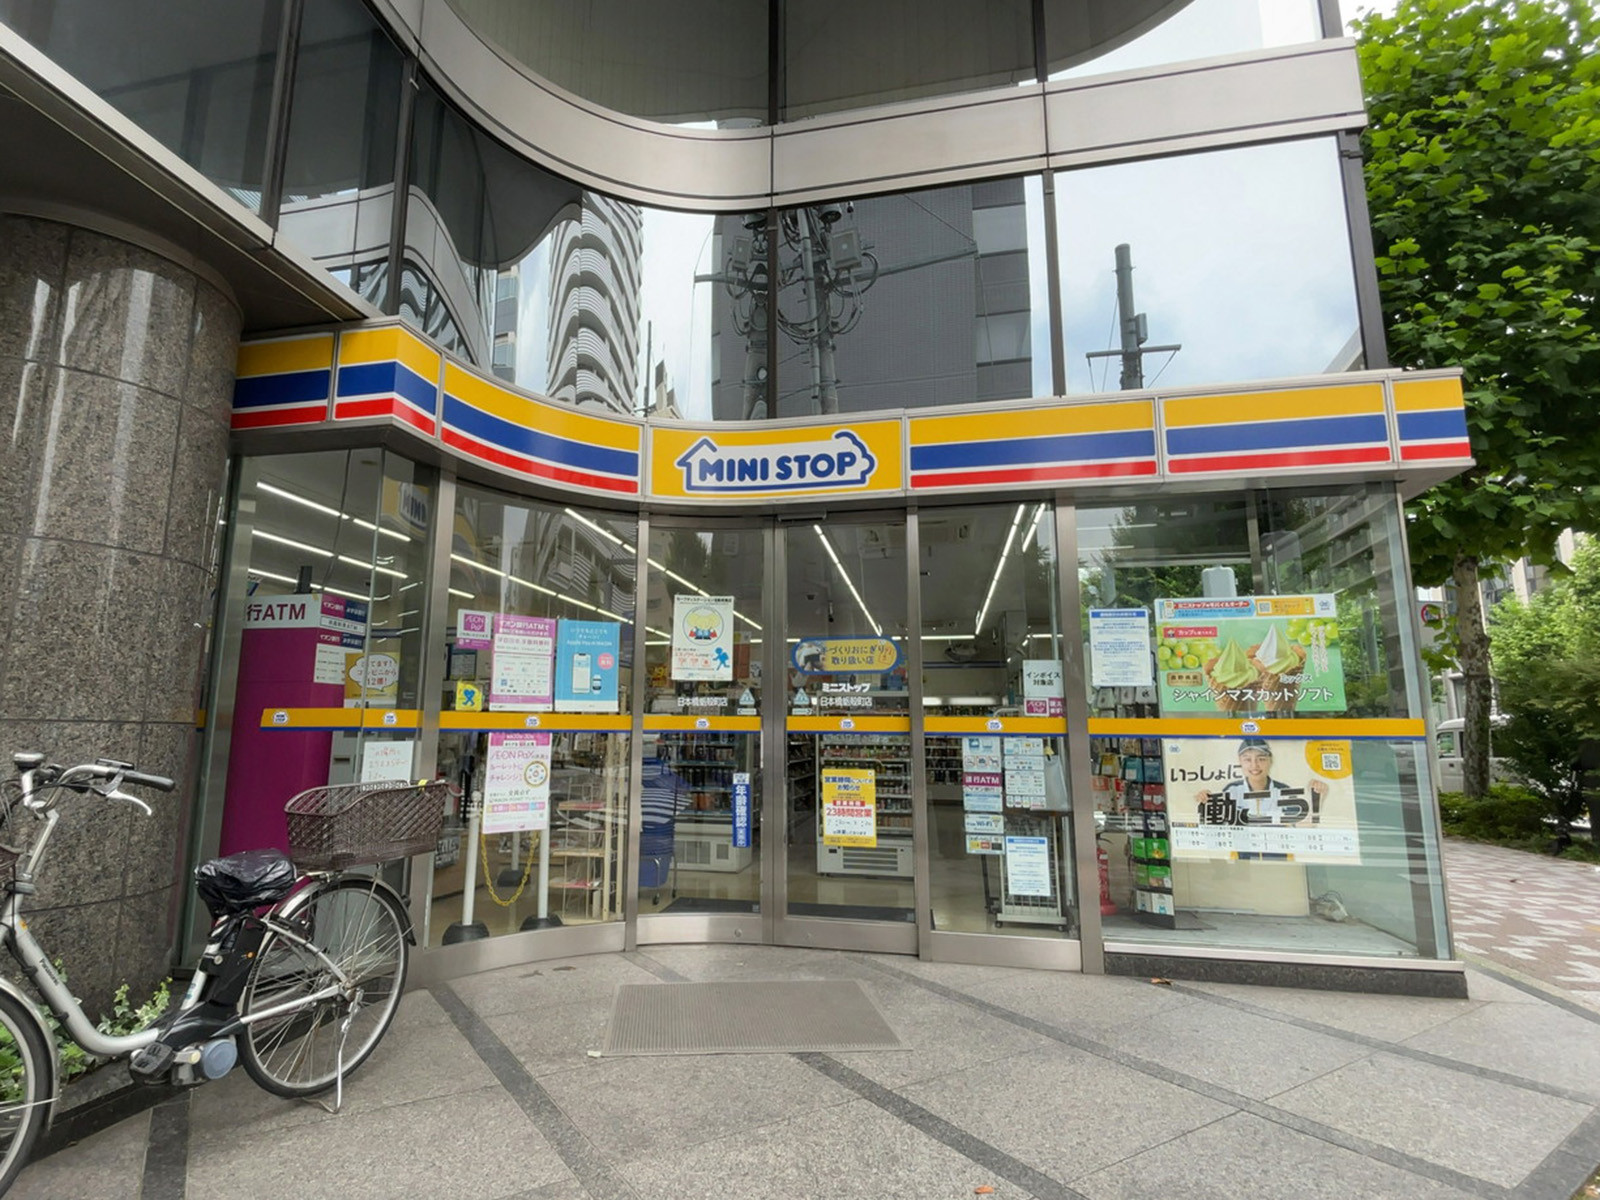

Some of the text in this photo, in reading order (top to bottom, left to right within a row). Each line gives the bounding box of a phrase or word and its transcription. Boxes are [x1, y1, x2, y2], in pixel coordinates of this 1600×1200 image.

[699, 451, 857, 482] MINI STOP
[1026, 671, 1061, 679] インボイス
[822, 683, 872, 693] ミニストップ
[1173, 686, 1334, 703] シャインマスカットソフト
[1170, 764, 1243, 782] いっしょに
[826, 808, 872, 818] 23時間営業
[1198, 788, 1321, 826] 働こう!
